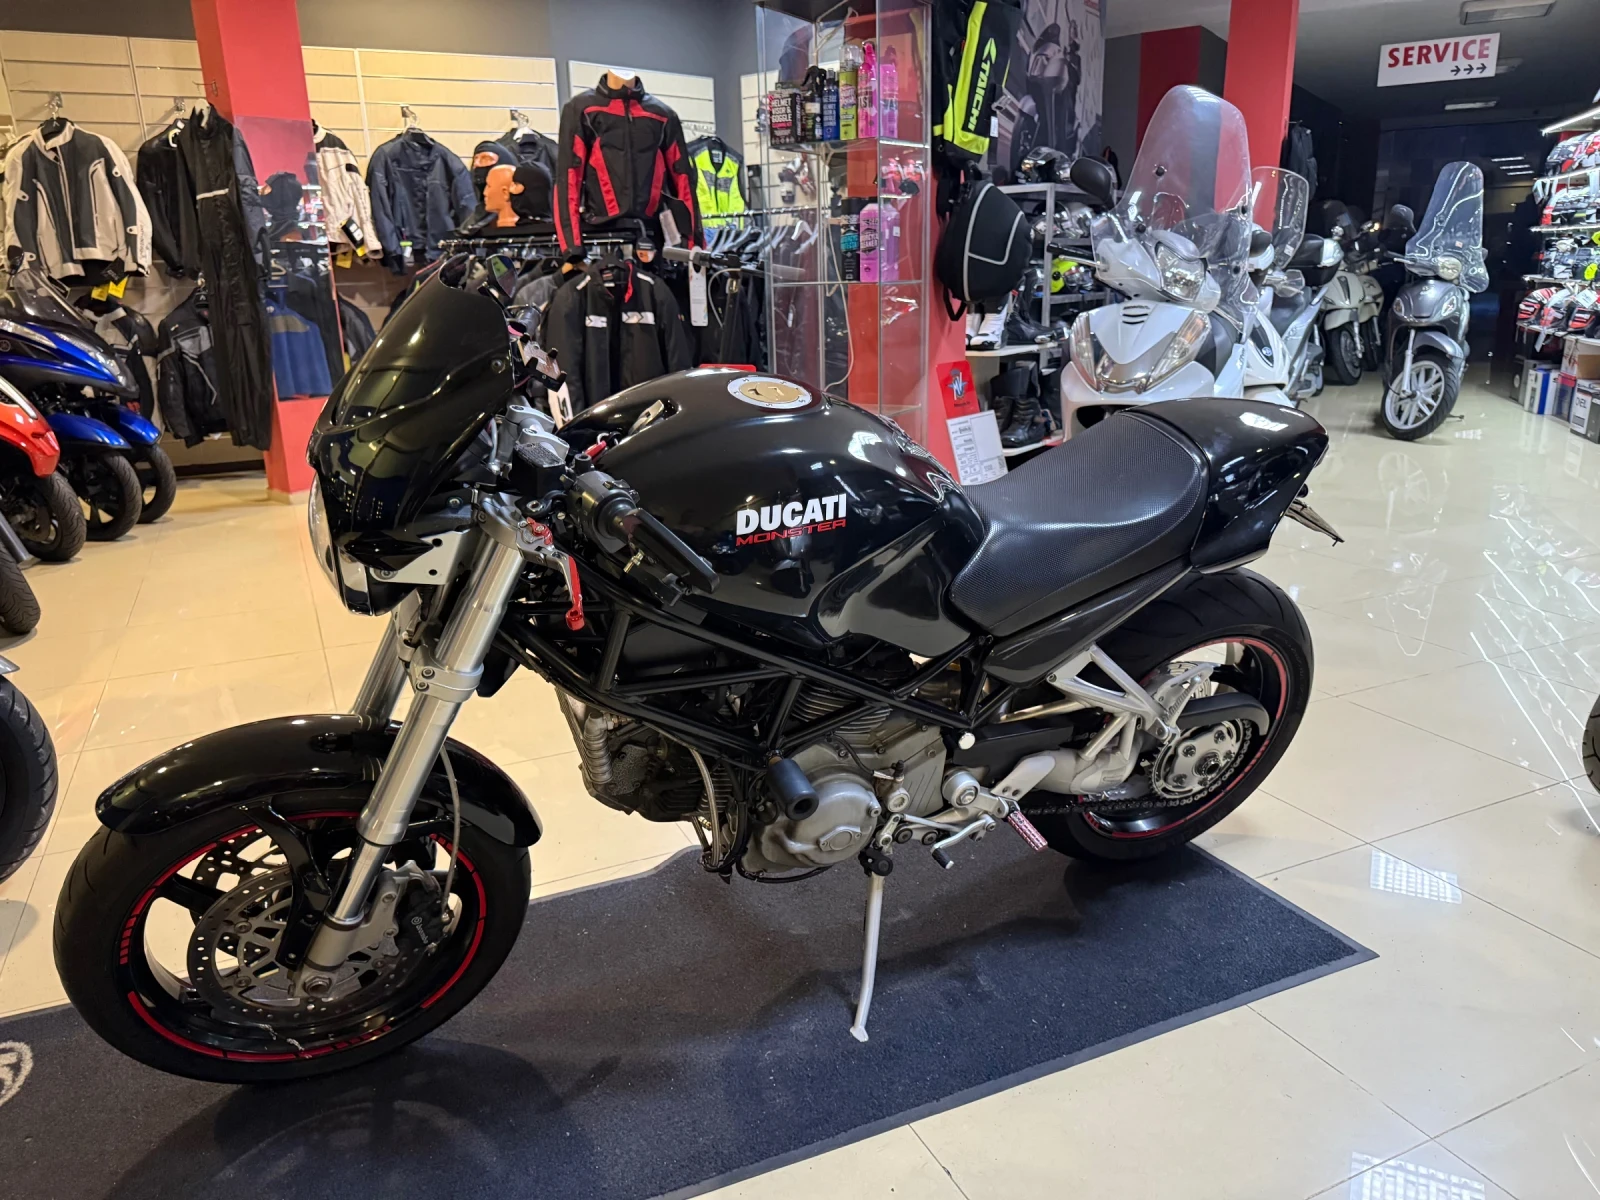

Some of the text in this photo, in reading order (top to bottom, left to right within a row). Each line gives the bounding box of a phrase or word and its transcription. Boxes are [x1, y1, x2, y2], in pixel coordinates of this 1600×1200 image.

[1387, 38, 1492, 68] SERVICE
[967, 59, 991, 131] TAICHI
[735, 518, 847, 547] MONSTER
[736, 493, 847, 536] DUCATI
